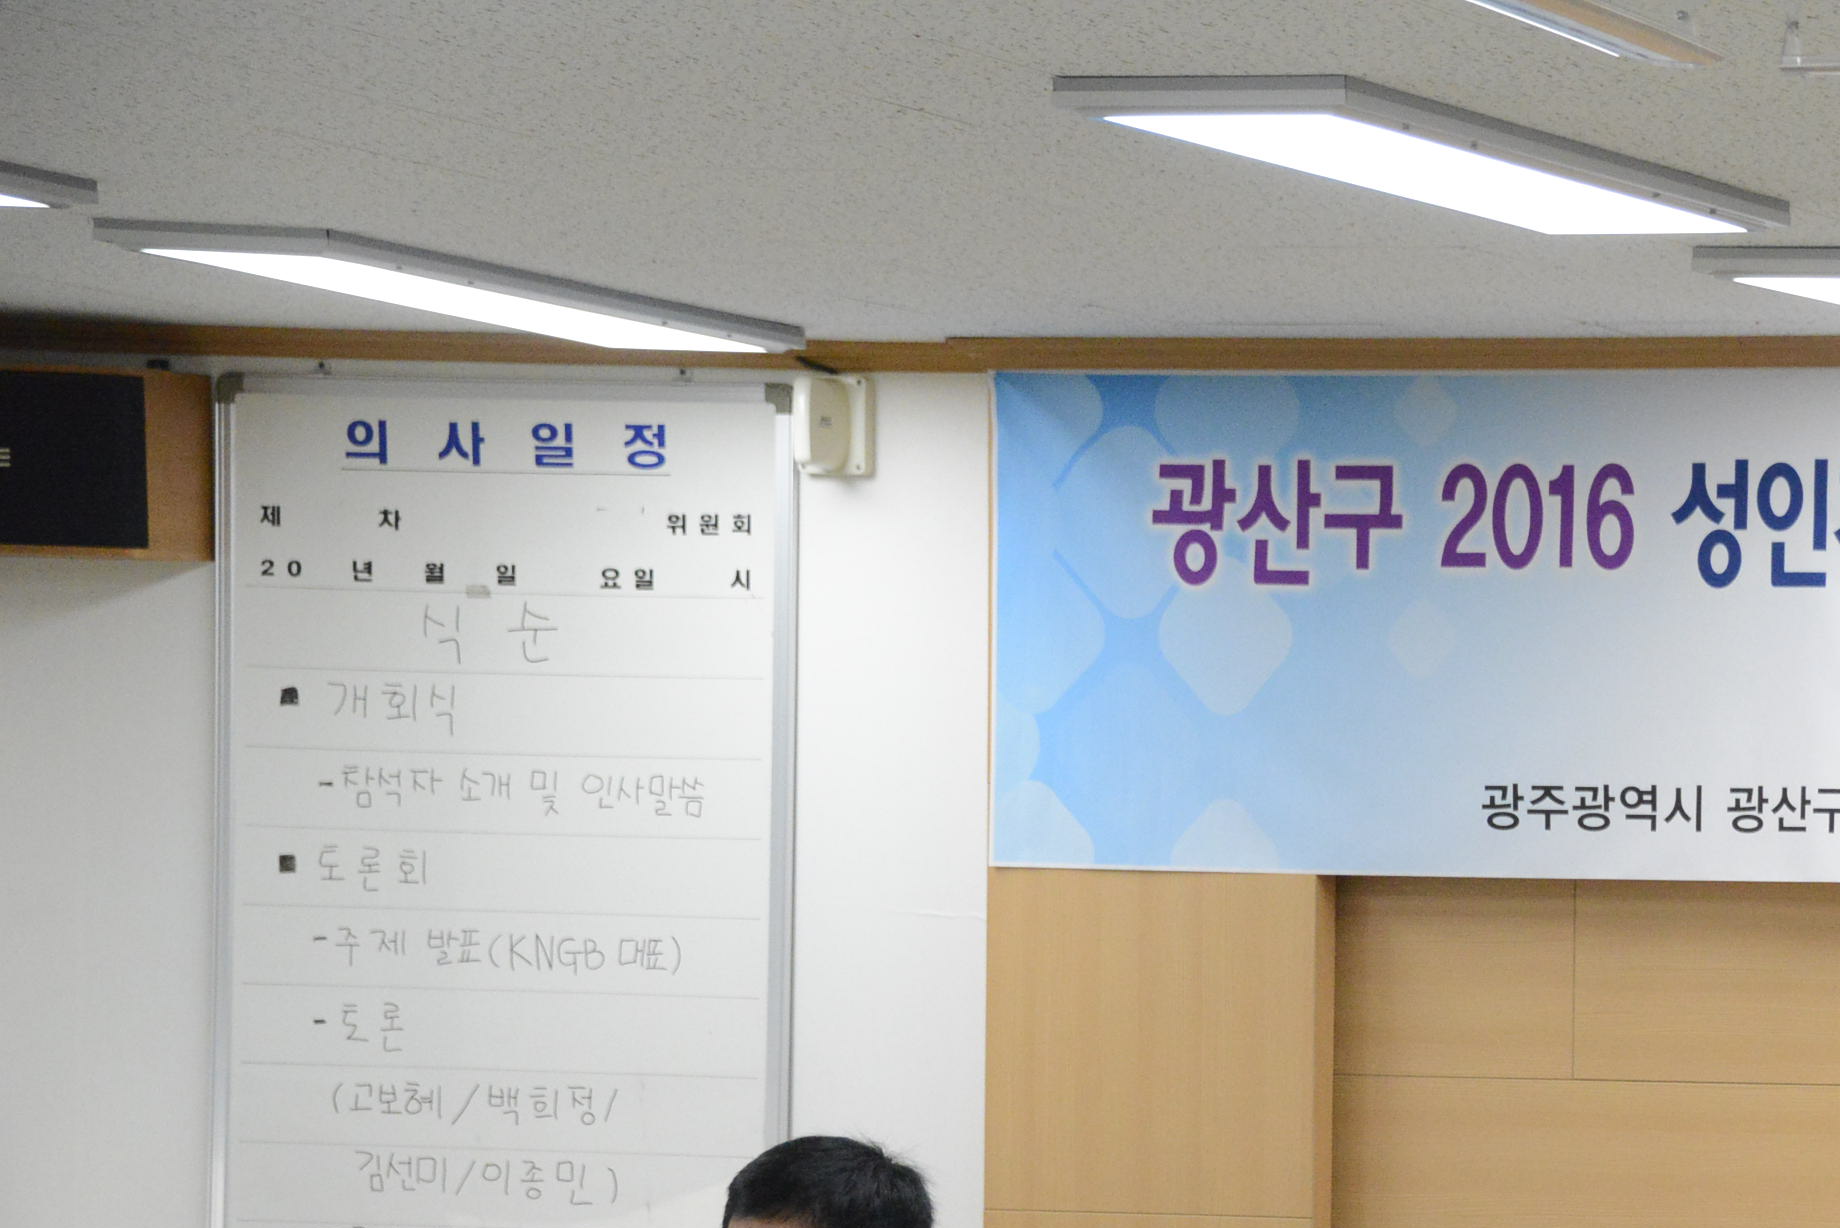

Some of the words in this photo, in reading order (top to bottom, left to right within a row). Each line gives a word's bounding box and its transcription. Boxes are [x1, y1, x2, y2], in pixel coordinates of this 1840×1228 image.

[345, 419, 667, 469] 의사일정
[260, 504, 281, 527] 제
[378, 508, 402, 531] 차
[666, 513, 752, 536] 위원회
[1151, 457, 1404, 588] 광산구
[1440, 462, 1635, 570] 2016
[260, 558, 303, 578] 20
[351, 559, 373, 583] 년
[424, 562, 445, 585] 월
[495, 563, 517, 587] 일
[599, 567, 654, 591] 요일
[730, 569, 751, 591] 시
[423, 601, 559, 665] 식순
[331, 682, 456, 736] 개회식
[459, 768, 511, 802] 소개
[529, 769, 559, 817] 및
[581, 773, 704, 819] 인사말씀
[1480, 782, 1703, 833] 광주광역시
[317, 844, 427, 893] 토론회
